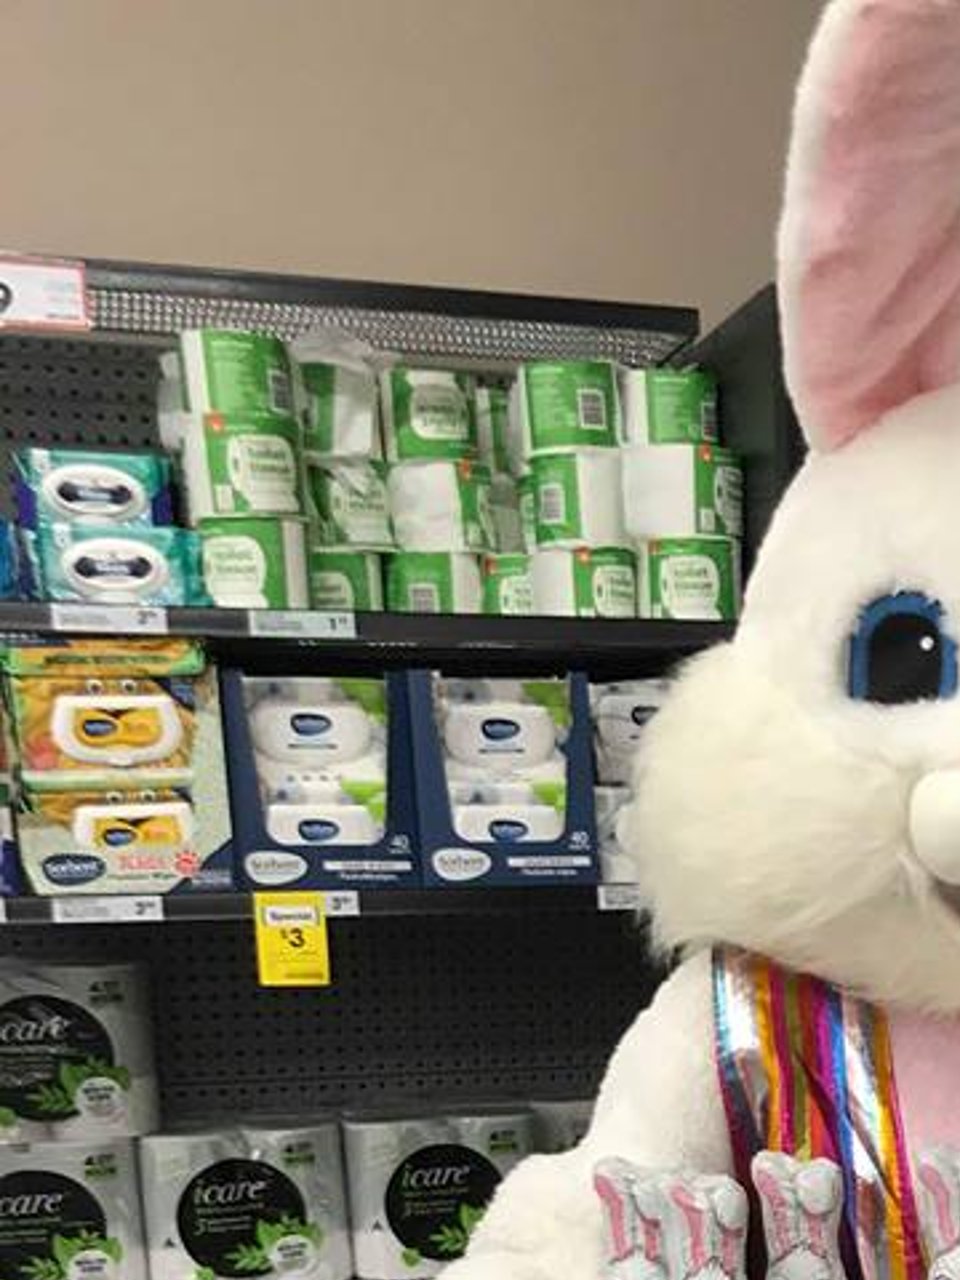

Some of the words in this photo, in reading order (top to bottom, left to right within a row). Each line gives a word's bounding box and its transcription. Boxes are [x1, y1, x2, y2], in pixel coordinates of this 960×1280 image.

[280, 926, 306, 948] $3
[0, 1016, 71, 1041] care
[401, 1163, 471, 1189] icare
[194, 1178, 267, 1204] icare
